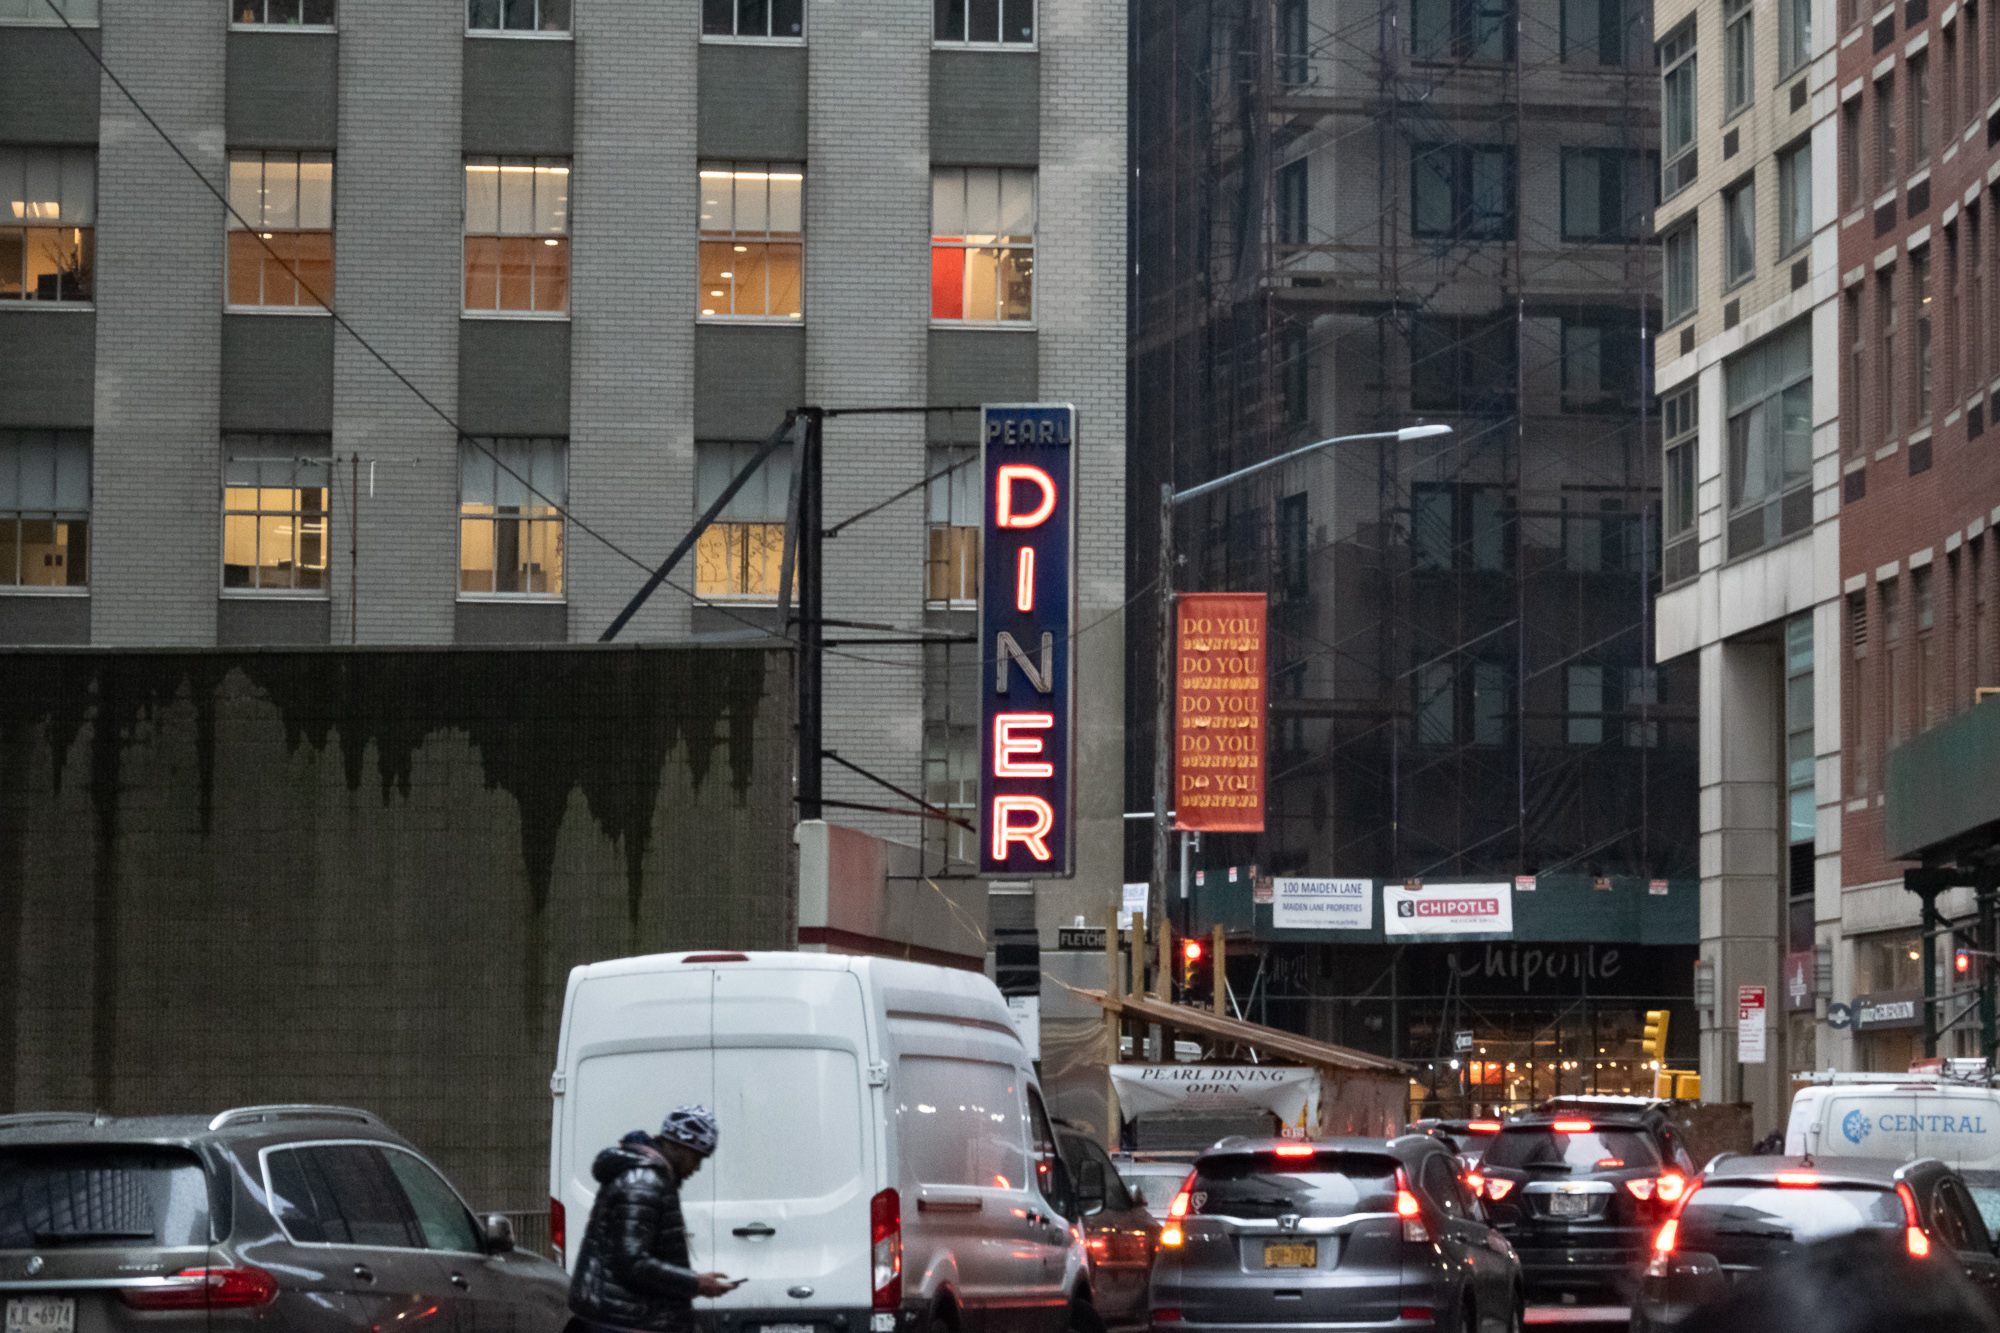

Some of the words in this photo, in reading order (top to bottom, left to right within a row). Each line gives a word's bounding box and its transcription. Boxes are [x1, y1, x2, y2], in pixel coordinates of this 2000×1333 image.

[985, 419, 1070, 445] PEARL
[1183, 618, 1212, 635] DO
[1217, 618, 1259, 635] YOU
[992, 463, 1057, 861] DINER
[1182, 657, 1212, 674] DO
[1216, 657, 1259, 674] YOU
[1182, 696, 1211, 713] DO
[1215, 696, 1259, 713] YOU
[1181, 735, 1210, 752] DO
[1215, 735, 1258, 752] YOU
[1181, 774, 1210, 791] DO
[1214, 774, 1258, 791] YOU
[1283, 882, 1299, 893] 100
[1301, 882, 1338, 894] MAIDEN
[1340, 883, 1363, 894] LANE
[1282, 903, 1308, 911] MAIDEN
[1309, 903, 1325, 912] LANE
[1326, 903, 1363, 912] PROPERTIES
[1419, 901, 1496, 914] CHIPOTLE
[1061, 932, 1106, 946] FLETCHE
[1141, 1068, 1206, 1081] PEARL
[1210, 1069, 1285, 1083] DINING
[1185, 1083, 1241, 1094] OPEN
[1879, 1114, 1987, 1134] CENTRAL
